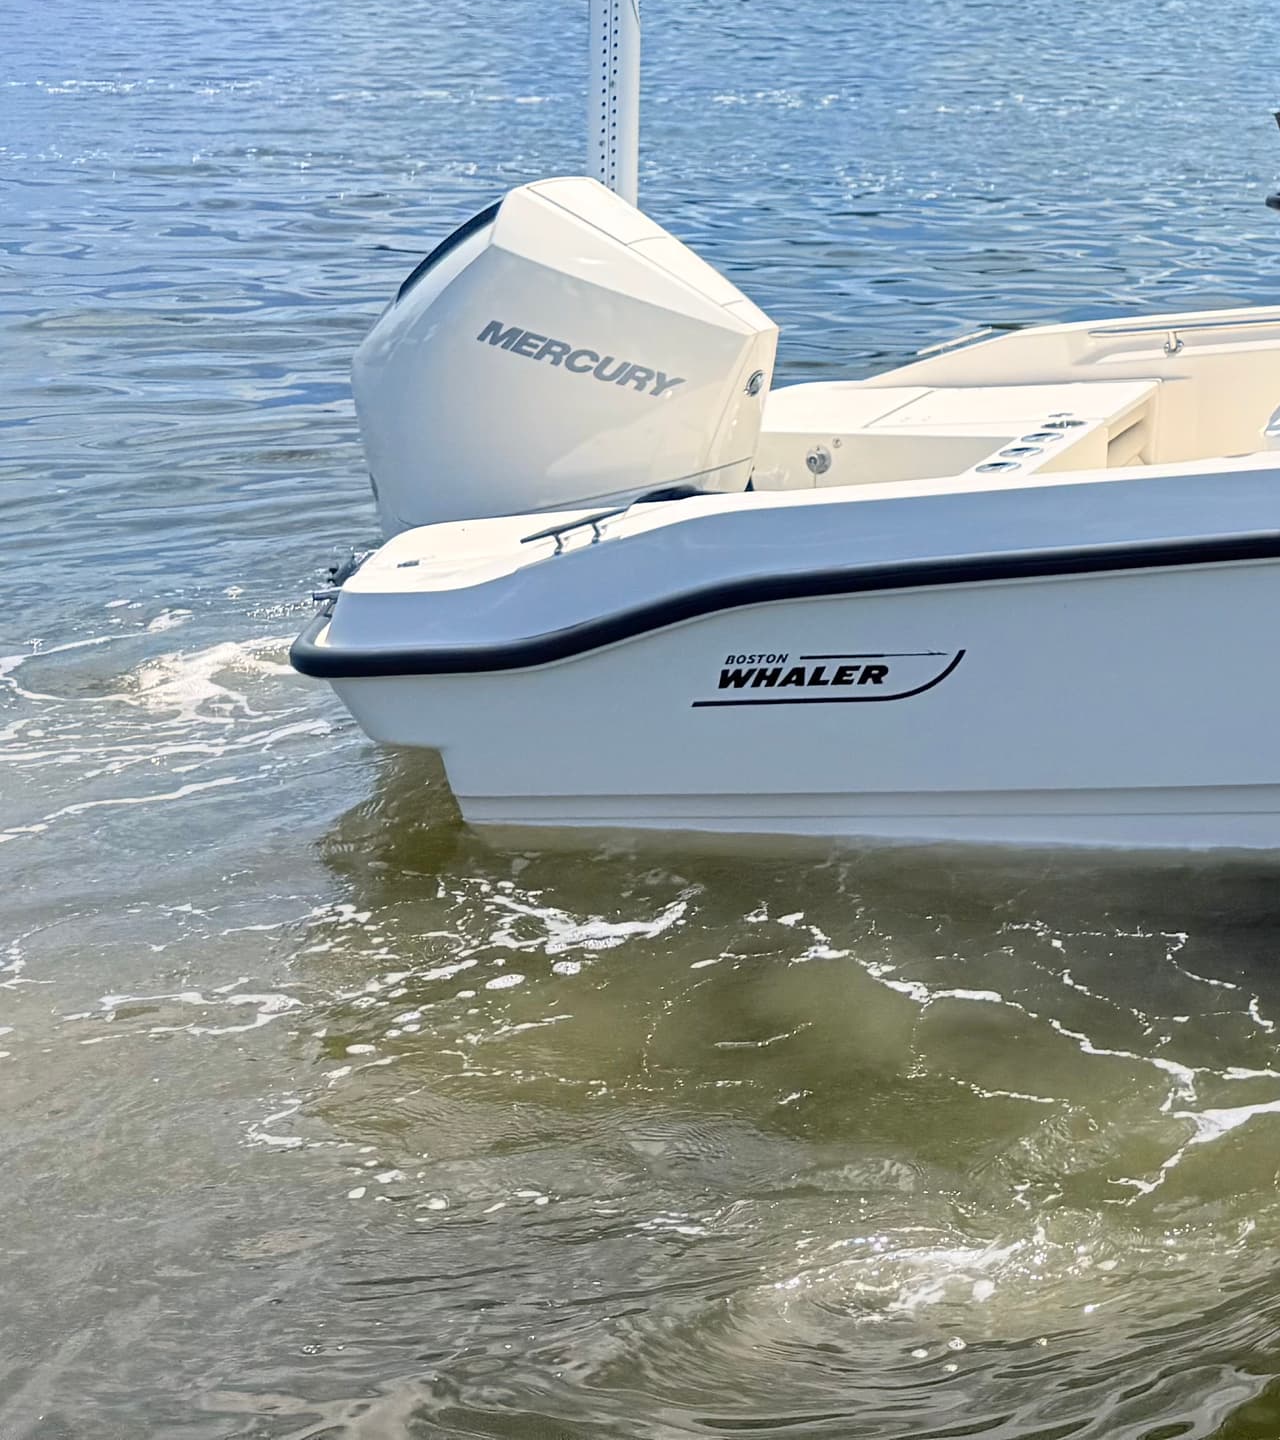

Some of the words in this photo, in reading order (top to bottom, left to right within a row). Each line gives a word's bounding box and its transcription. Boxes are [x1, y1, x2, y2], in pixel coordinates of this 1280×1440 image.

[476, 320, 687, 396] MERCURY
[725, 653, 789, 665] BOSTON
[718, 665, 889, 689] WHALER
